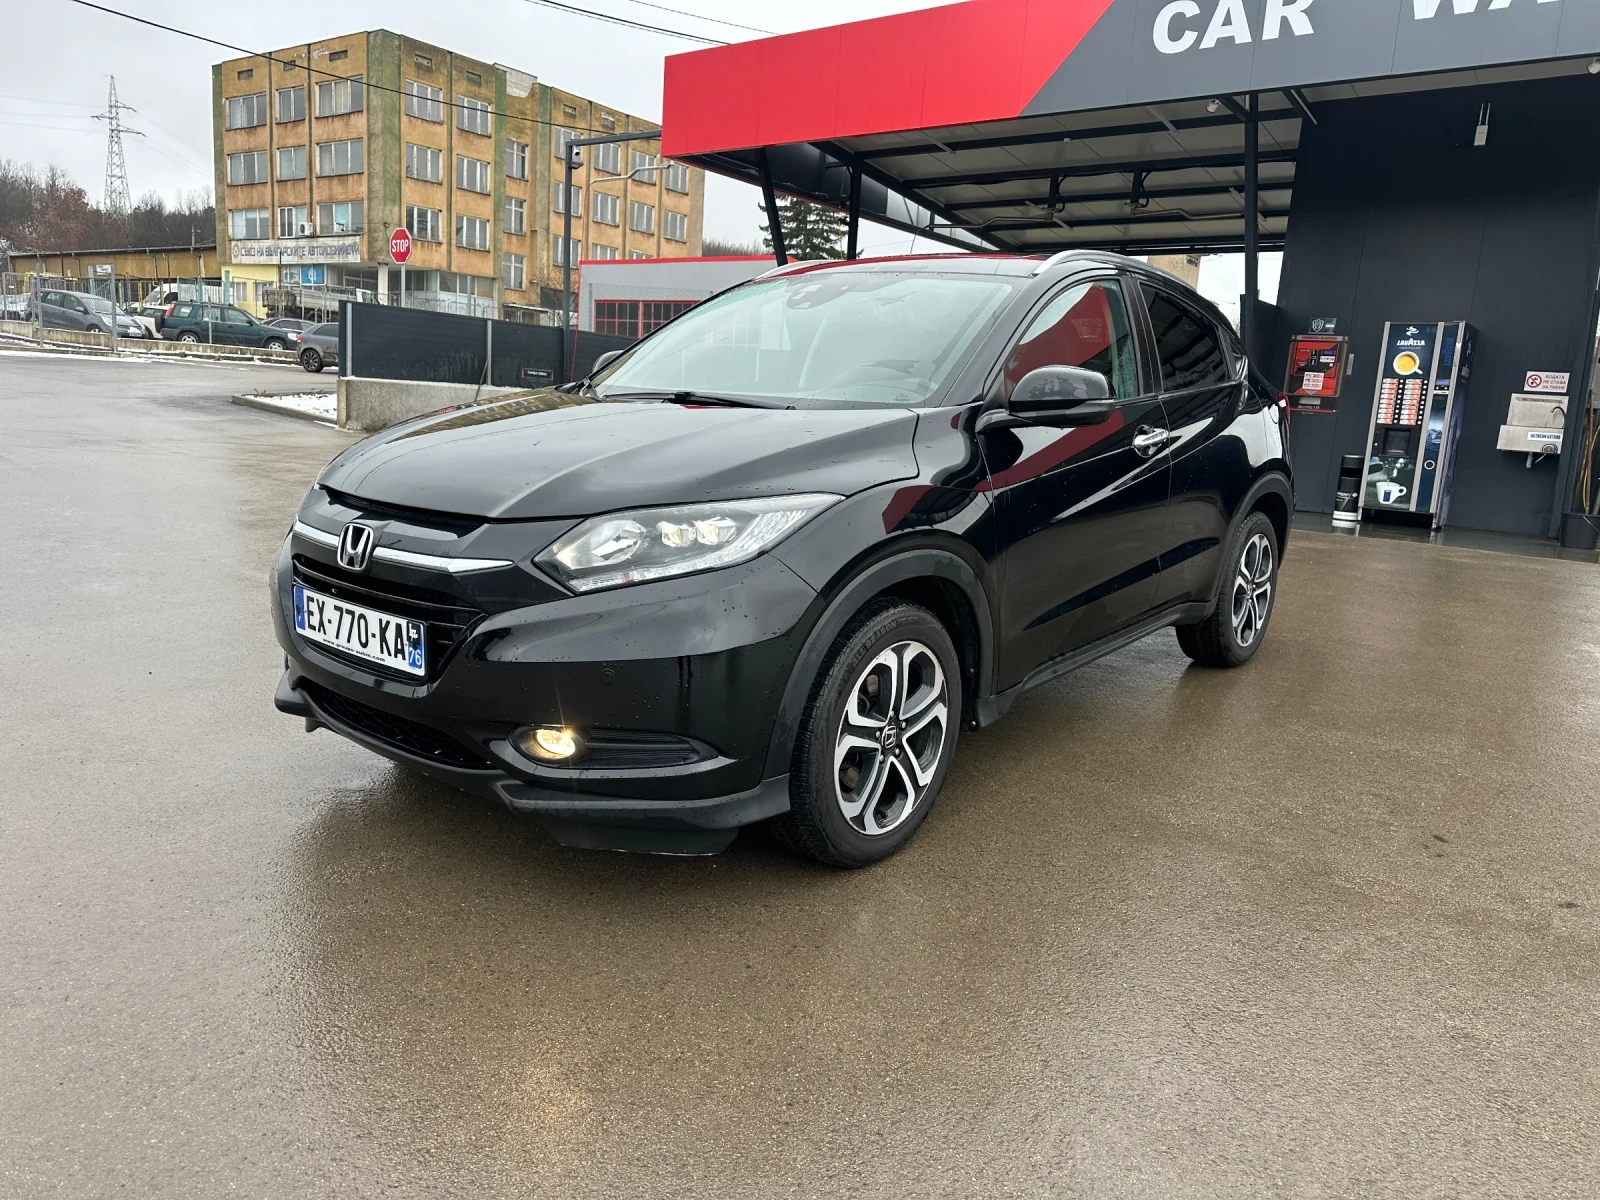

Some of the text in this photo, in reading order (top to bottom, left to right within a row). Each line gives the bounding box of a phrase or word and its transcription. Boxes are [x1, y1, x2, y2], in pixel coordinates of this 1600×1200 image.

[1152, 0, 1315, 54] CAR
[257, 247, 264, 257] НА
[391, 239, 409, 253] STOP
[1396, 338, 1426, 346] LAVAZZA
[306, 595, 406, 661] EX-770-KA
[408, 647, 421, 665] 76
